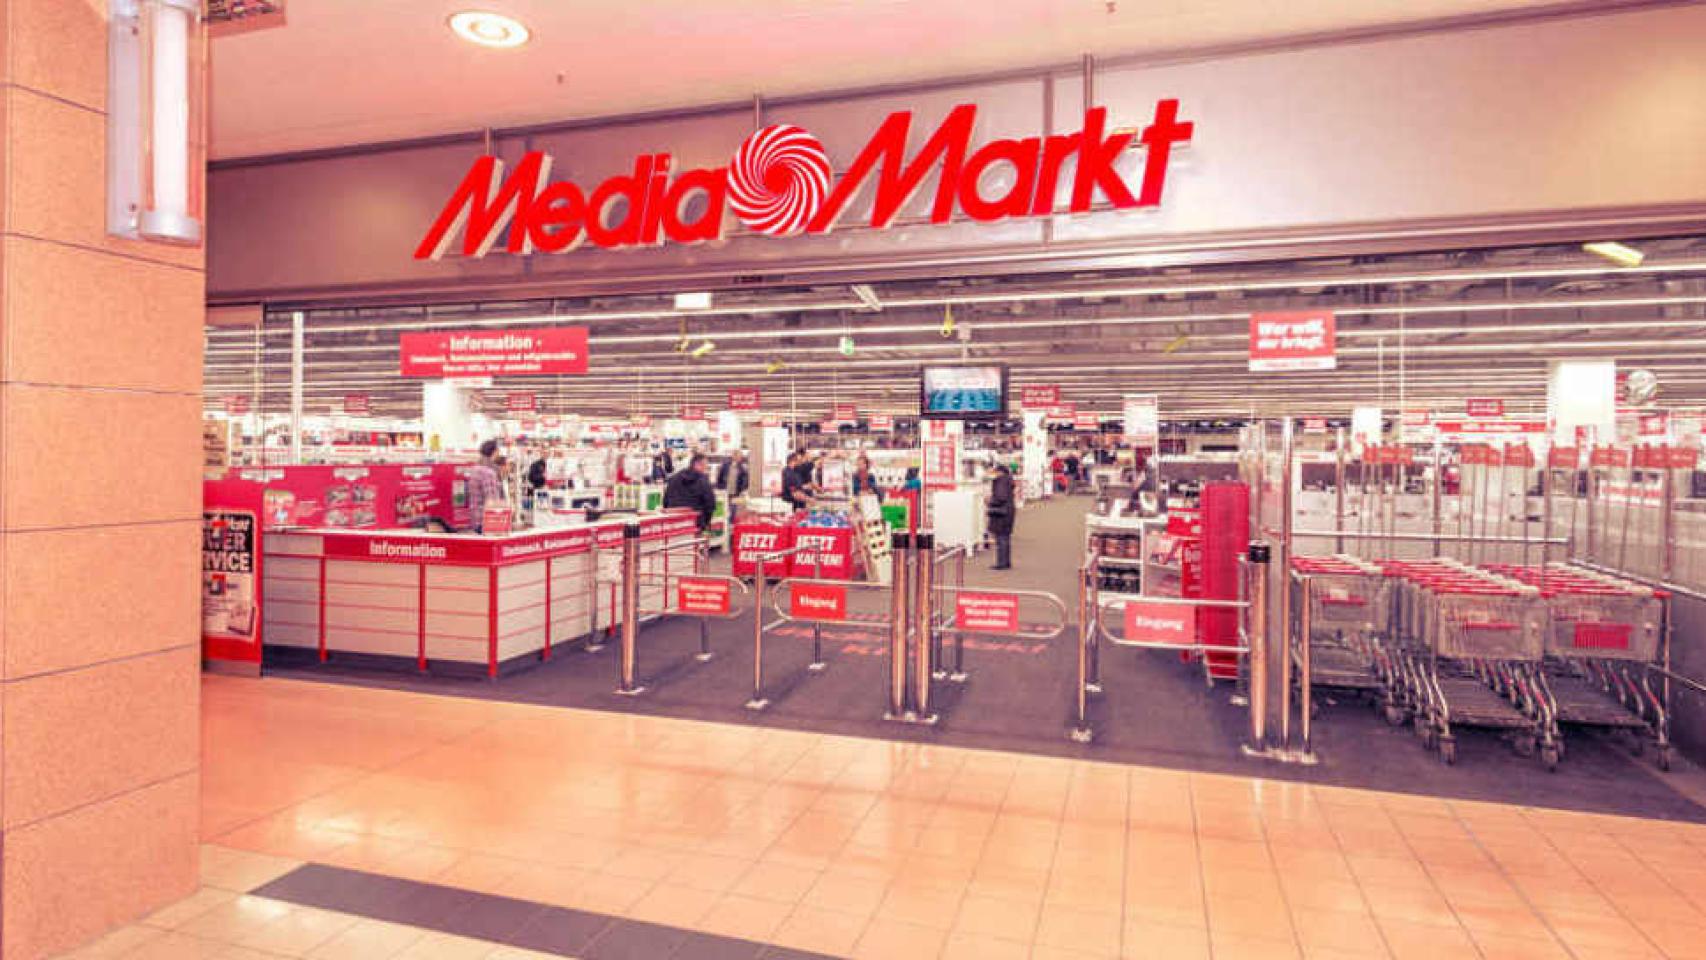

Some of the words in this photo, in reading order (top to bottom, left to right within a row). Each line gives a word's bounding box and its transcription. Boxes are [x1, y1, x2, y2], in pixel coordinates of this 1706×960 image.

[414, 150, 729, 259] Media
[808, 98, 1194, 233] Markt
[450, 335, 533, 351] Information
[369, 539, 447, 558] Information
[738, 532, 778, 550] JETZT
[1135, 614, 1184, 632] Eingang
